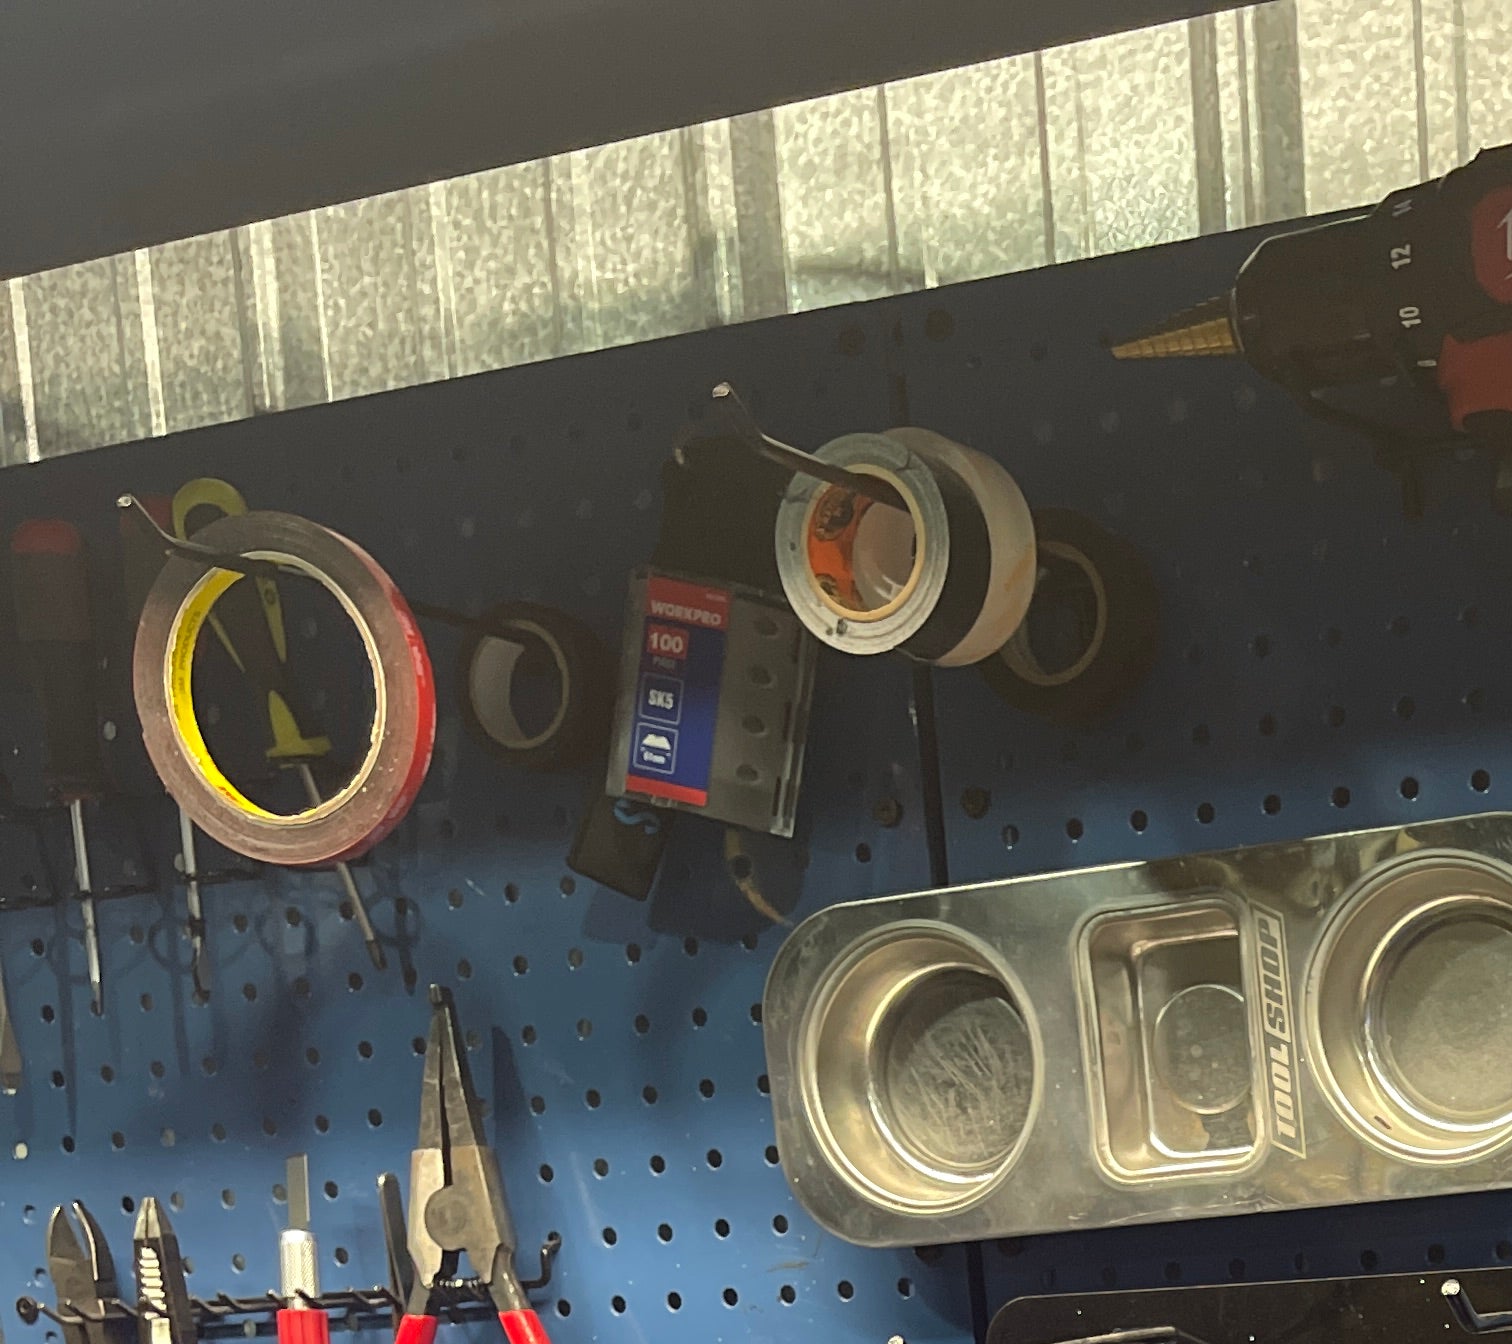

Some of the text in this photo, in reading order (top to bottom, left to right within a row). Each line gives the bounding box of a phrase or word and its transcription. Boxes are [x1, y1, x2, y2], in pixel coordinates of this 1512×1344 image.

[1391, 244, 1411, 269] 12
[1399, 306, 1422, 328] 10
[651, 601, 723, 626] WORKPRO
[651, 630, 684, 654] 100
[1257, 917, 1297, 1139] TOOL SHOP
